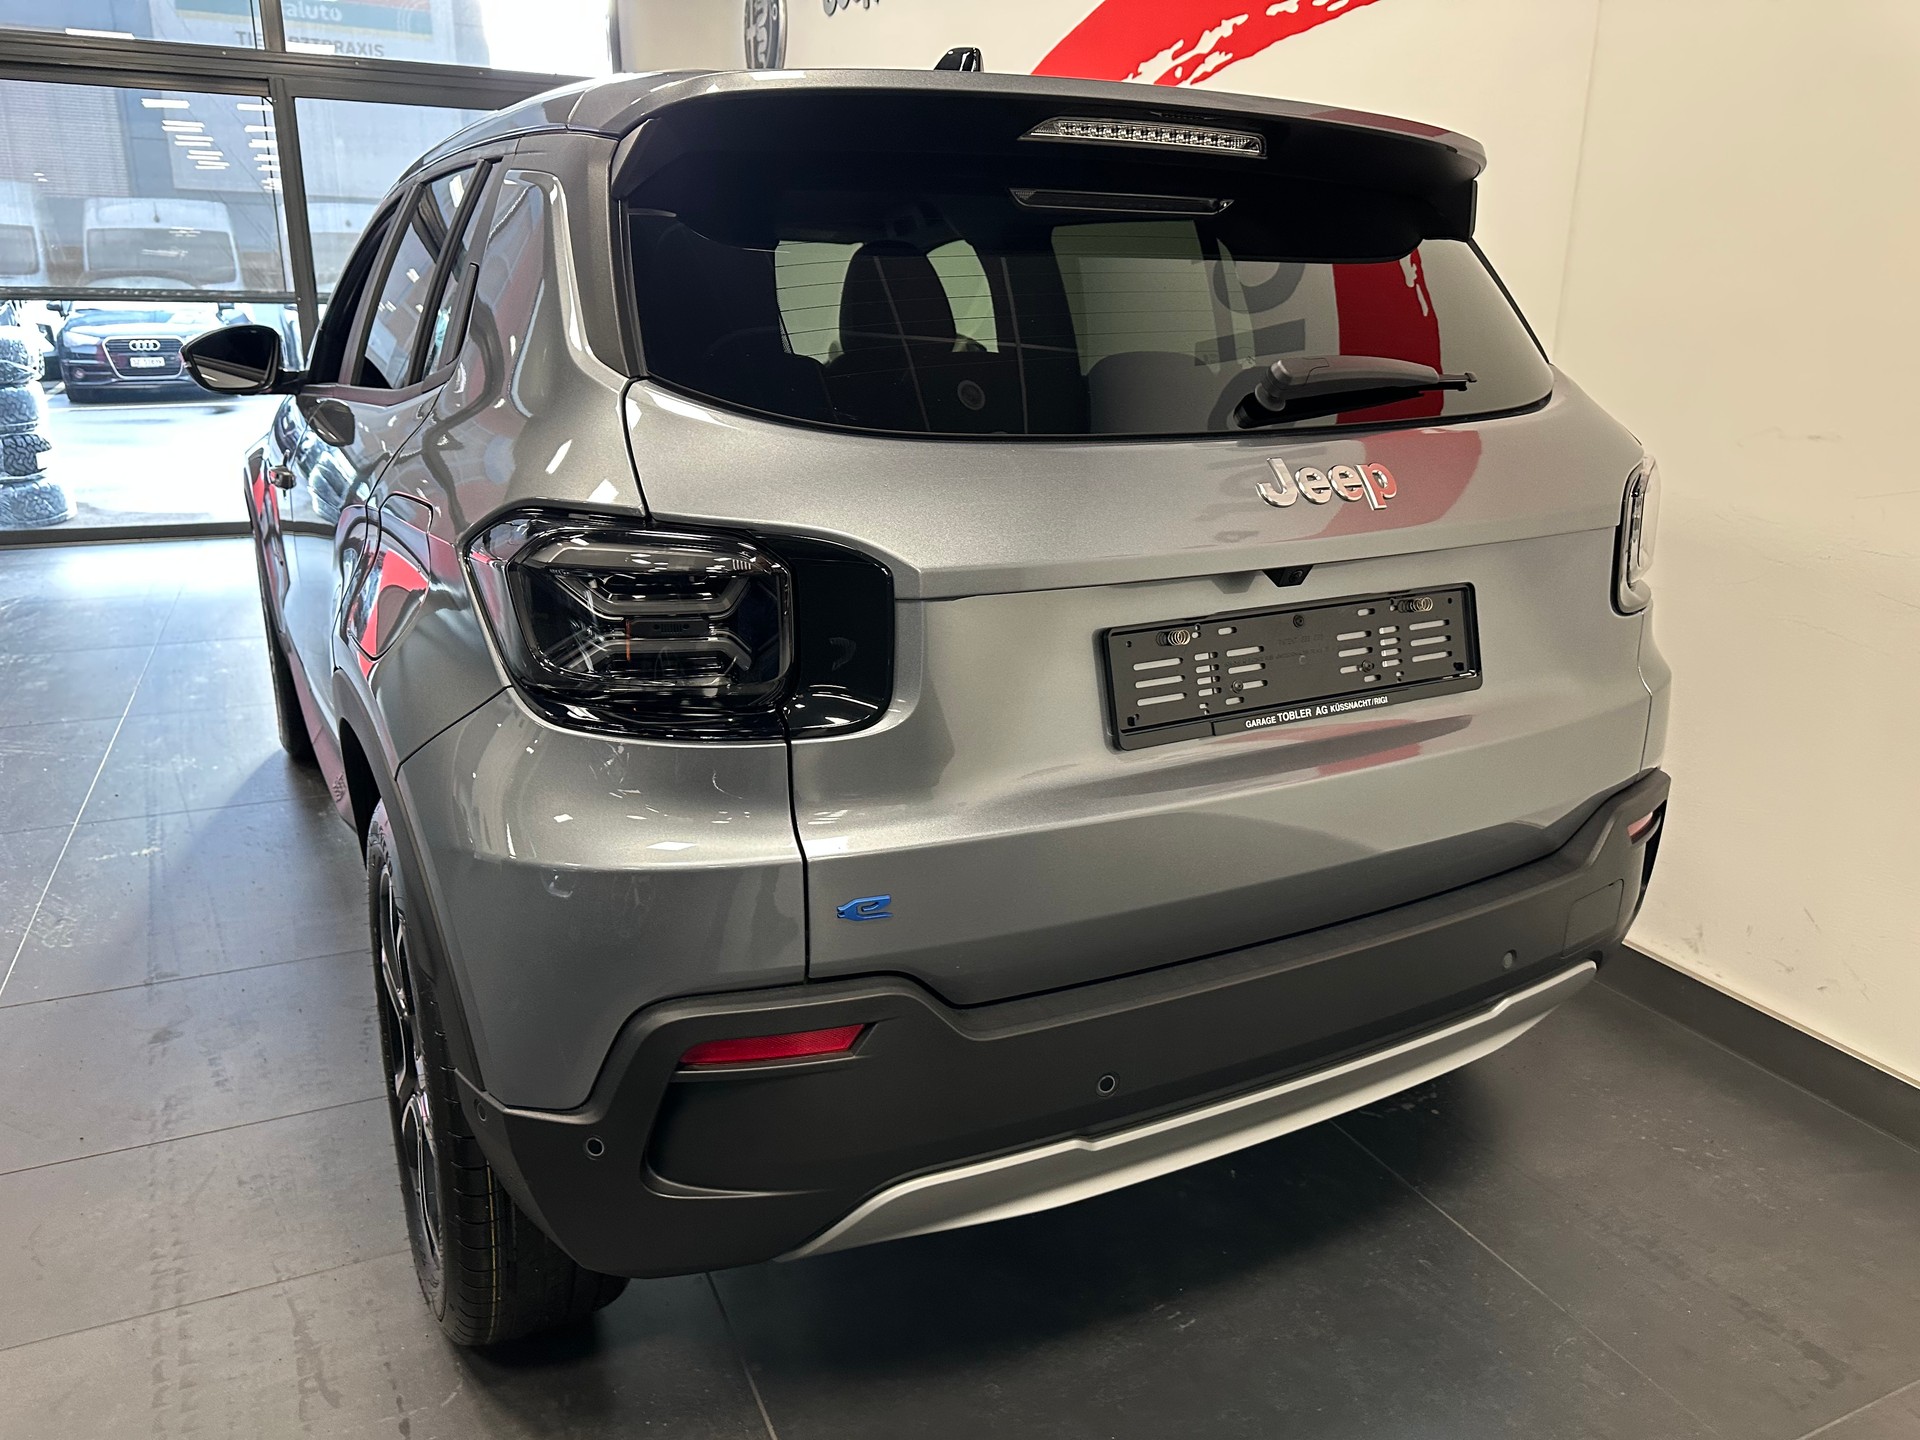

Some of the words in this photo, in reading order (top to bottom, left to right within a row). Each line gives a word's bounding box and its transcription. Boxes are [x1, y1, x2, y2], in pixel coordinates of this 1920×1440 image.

[1255, 457, 1397, 510] Jeep
[1245, 715, 1277, 728] GARAGE
[1277, 708, 1312, 722] TOBLER
[1315, 705, 1329, 716] AG
[1330, 696, 1388, 713] KÜSSNACHT/RIGI
